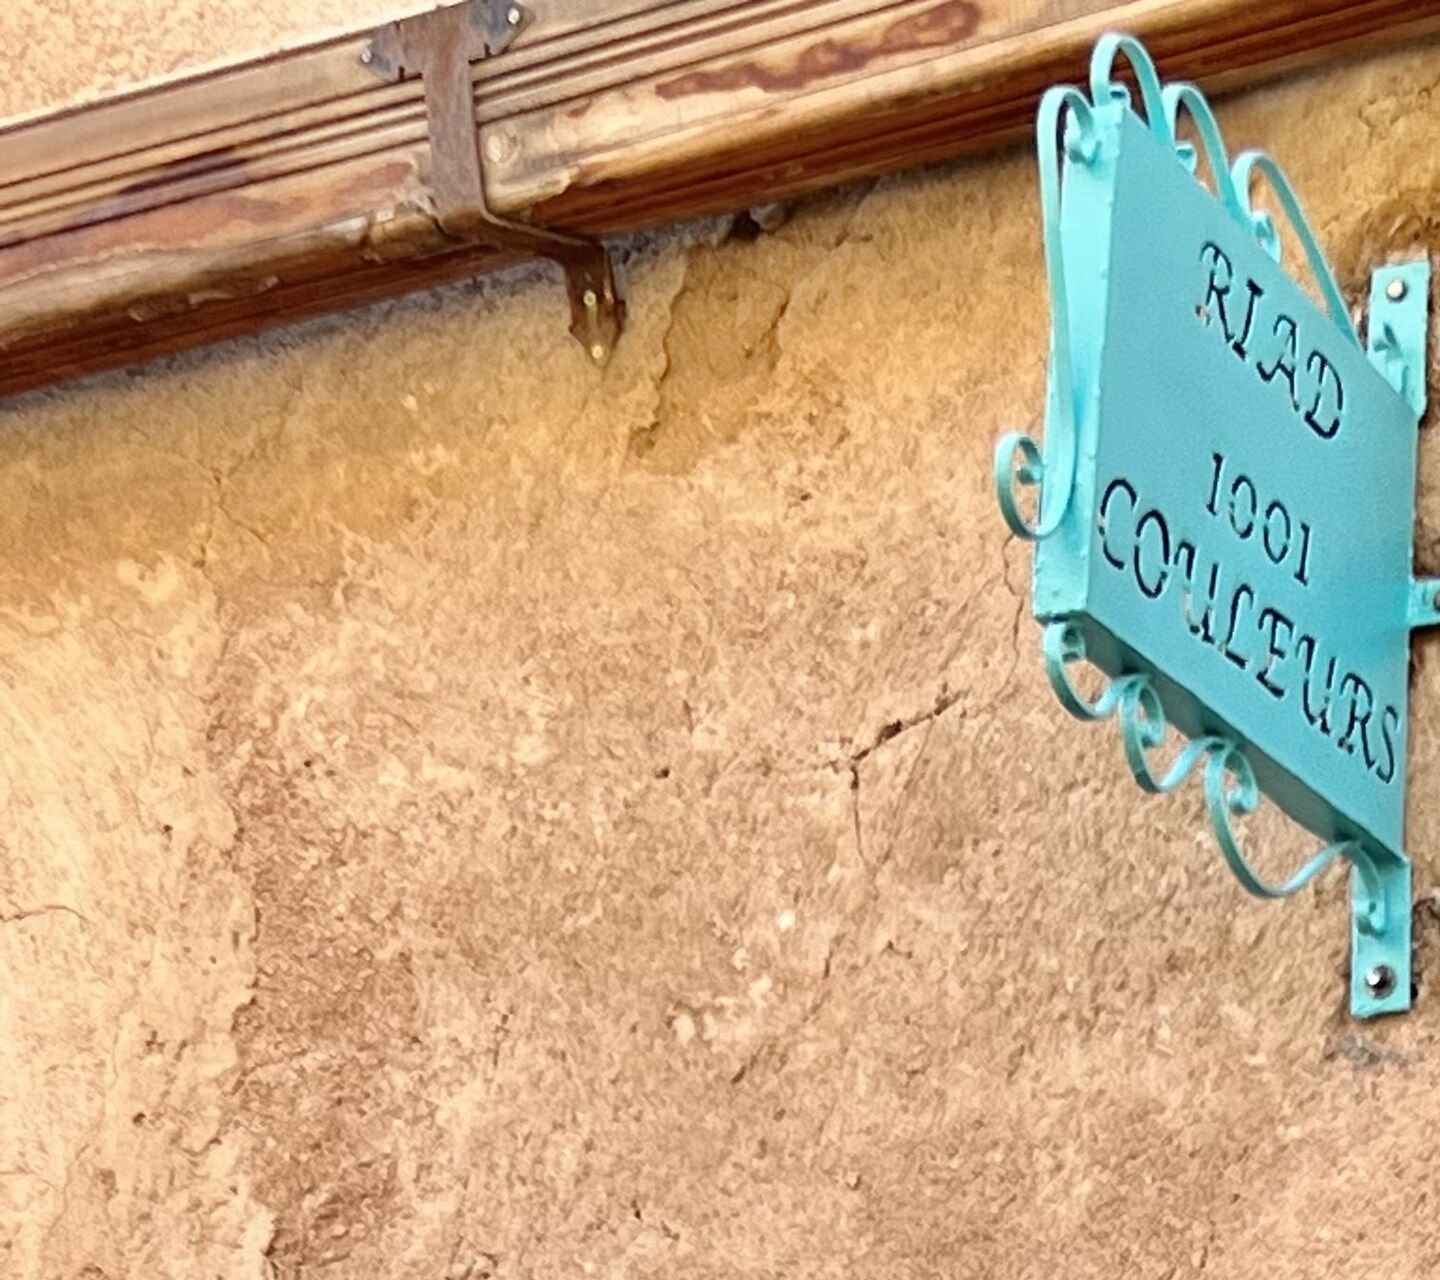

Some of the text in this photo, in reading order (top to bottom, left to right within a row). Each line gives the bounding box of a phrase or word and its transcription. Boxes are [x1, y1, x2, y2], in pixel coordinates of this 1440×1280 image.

[1195, 241, 1345, 440] RIAD
[1205, 451, 1312, 587] 1001
[1097, 477, 1399, 785] COULEURS
